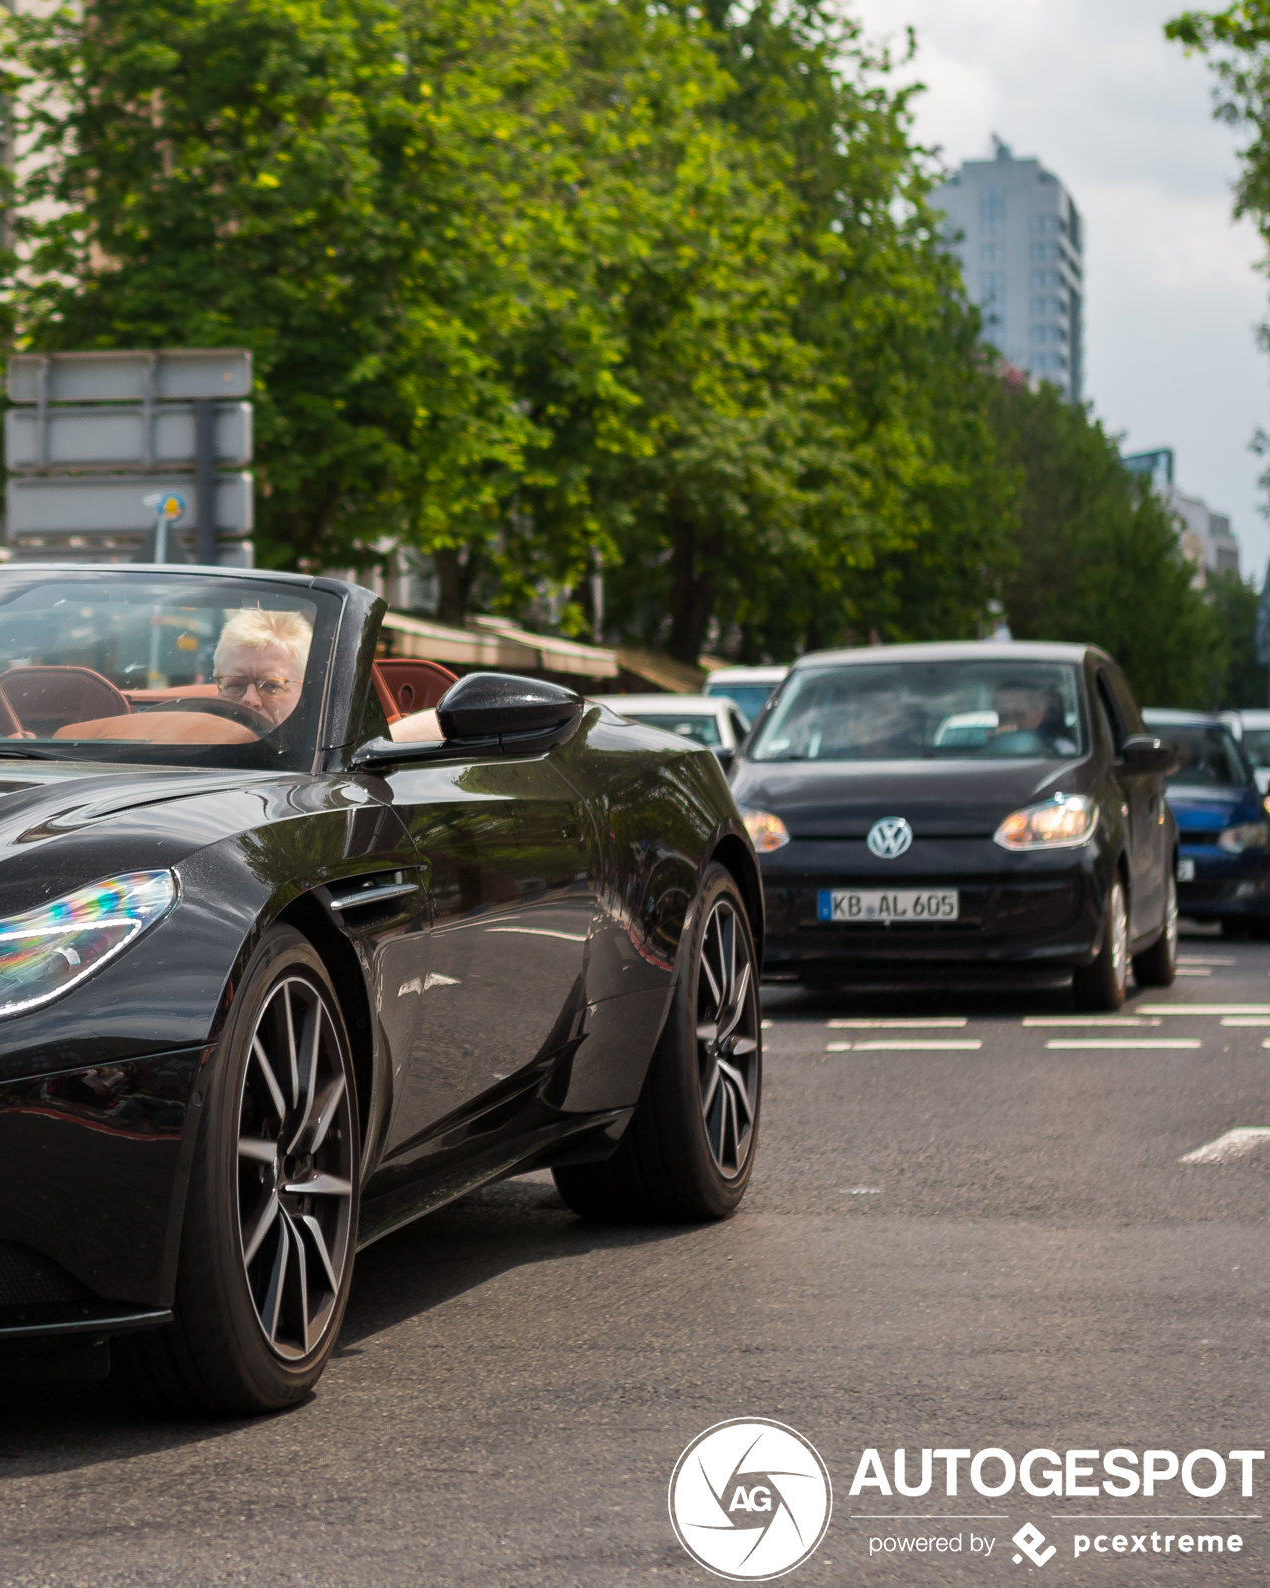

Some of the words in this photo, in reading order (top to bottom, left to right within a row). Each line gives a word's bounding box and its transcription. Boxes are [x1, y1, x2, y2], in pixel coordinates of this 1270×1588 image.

[832, 895, 862, 917] KB
[878, 895, 906, 916] AL
[912, 894, 954, 916] 605
